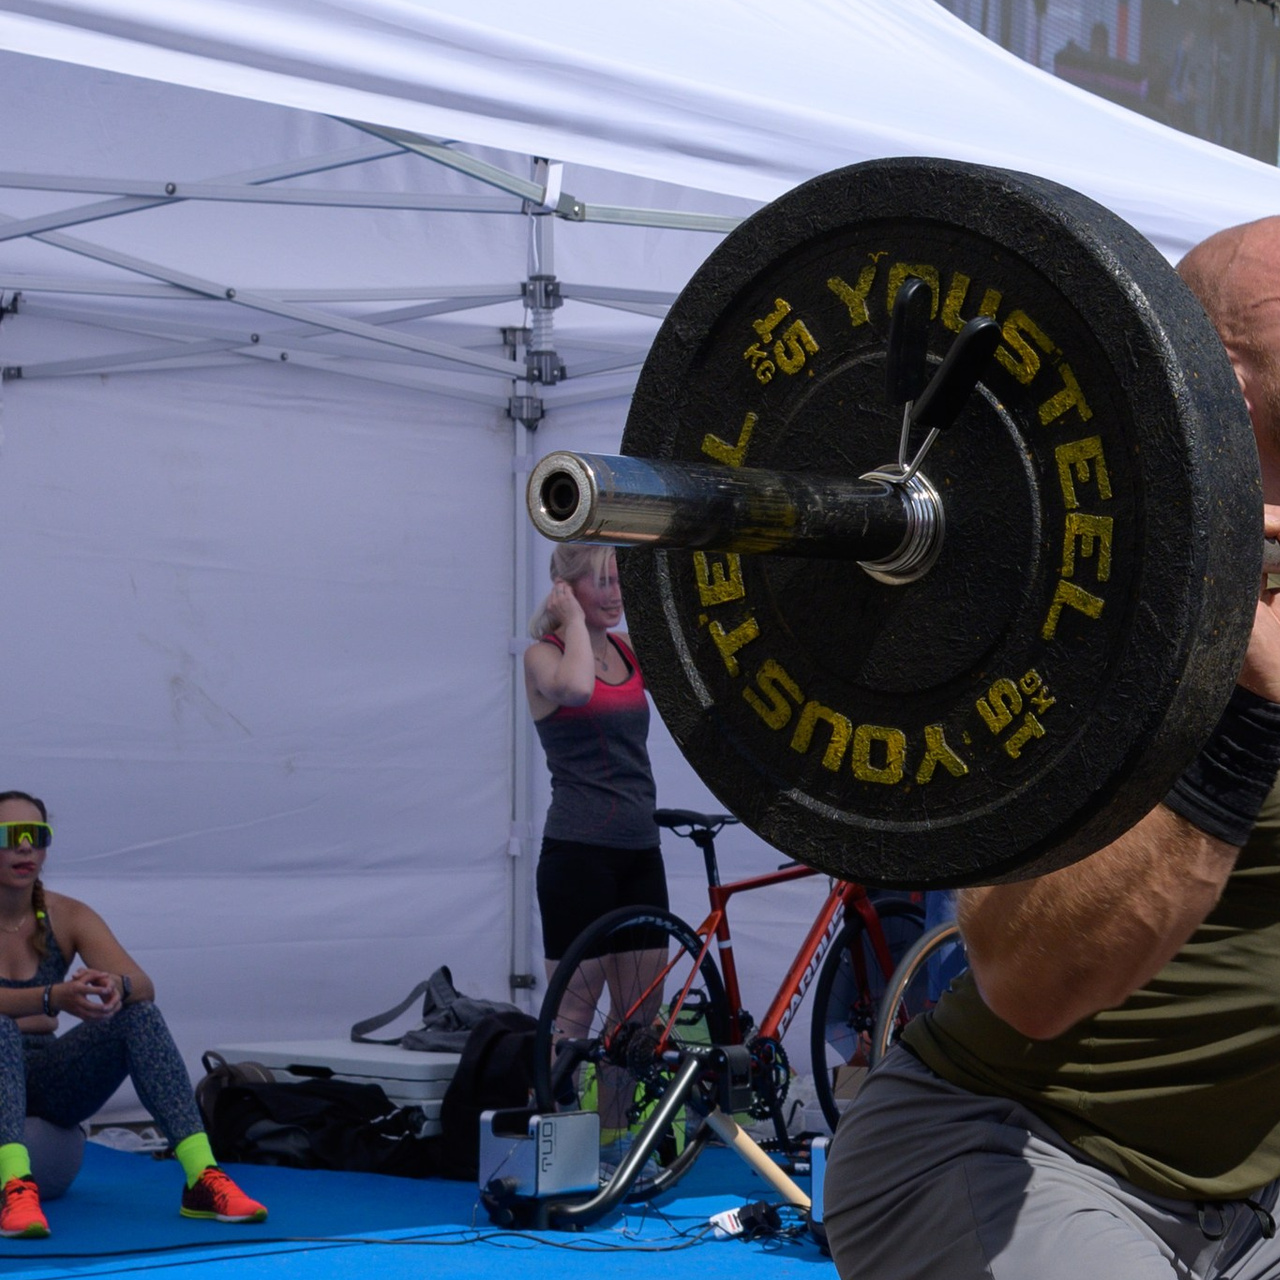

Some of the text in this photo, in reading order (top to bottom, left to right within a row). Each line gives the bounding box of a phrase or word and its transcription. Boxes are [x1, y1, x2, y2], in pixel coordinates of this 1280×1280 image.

[743, 297, 820, 385] 15 KG
[693, 412, 969, 785] YOUSTEL
[976, 677, 1046, 759] 15
[777, 899, 846, 1041] PARDUS
